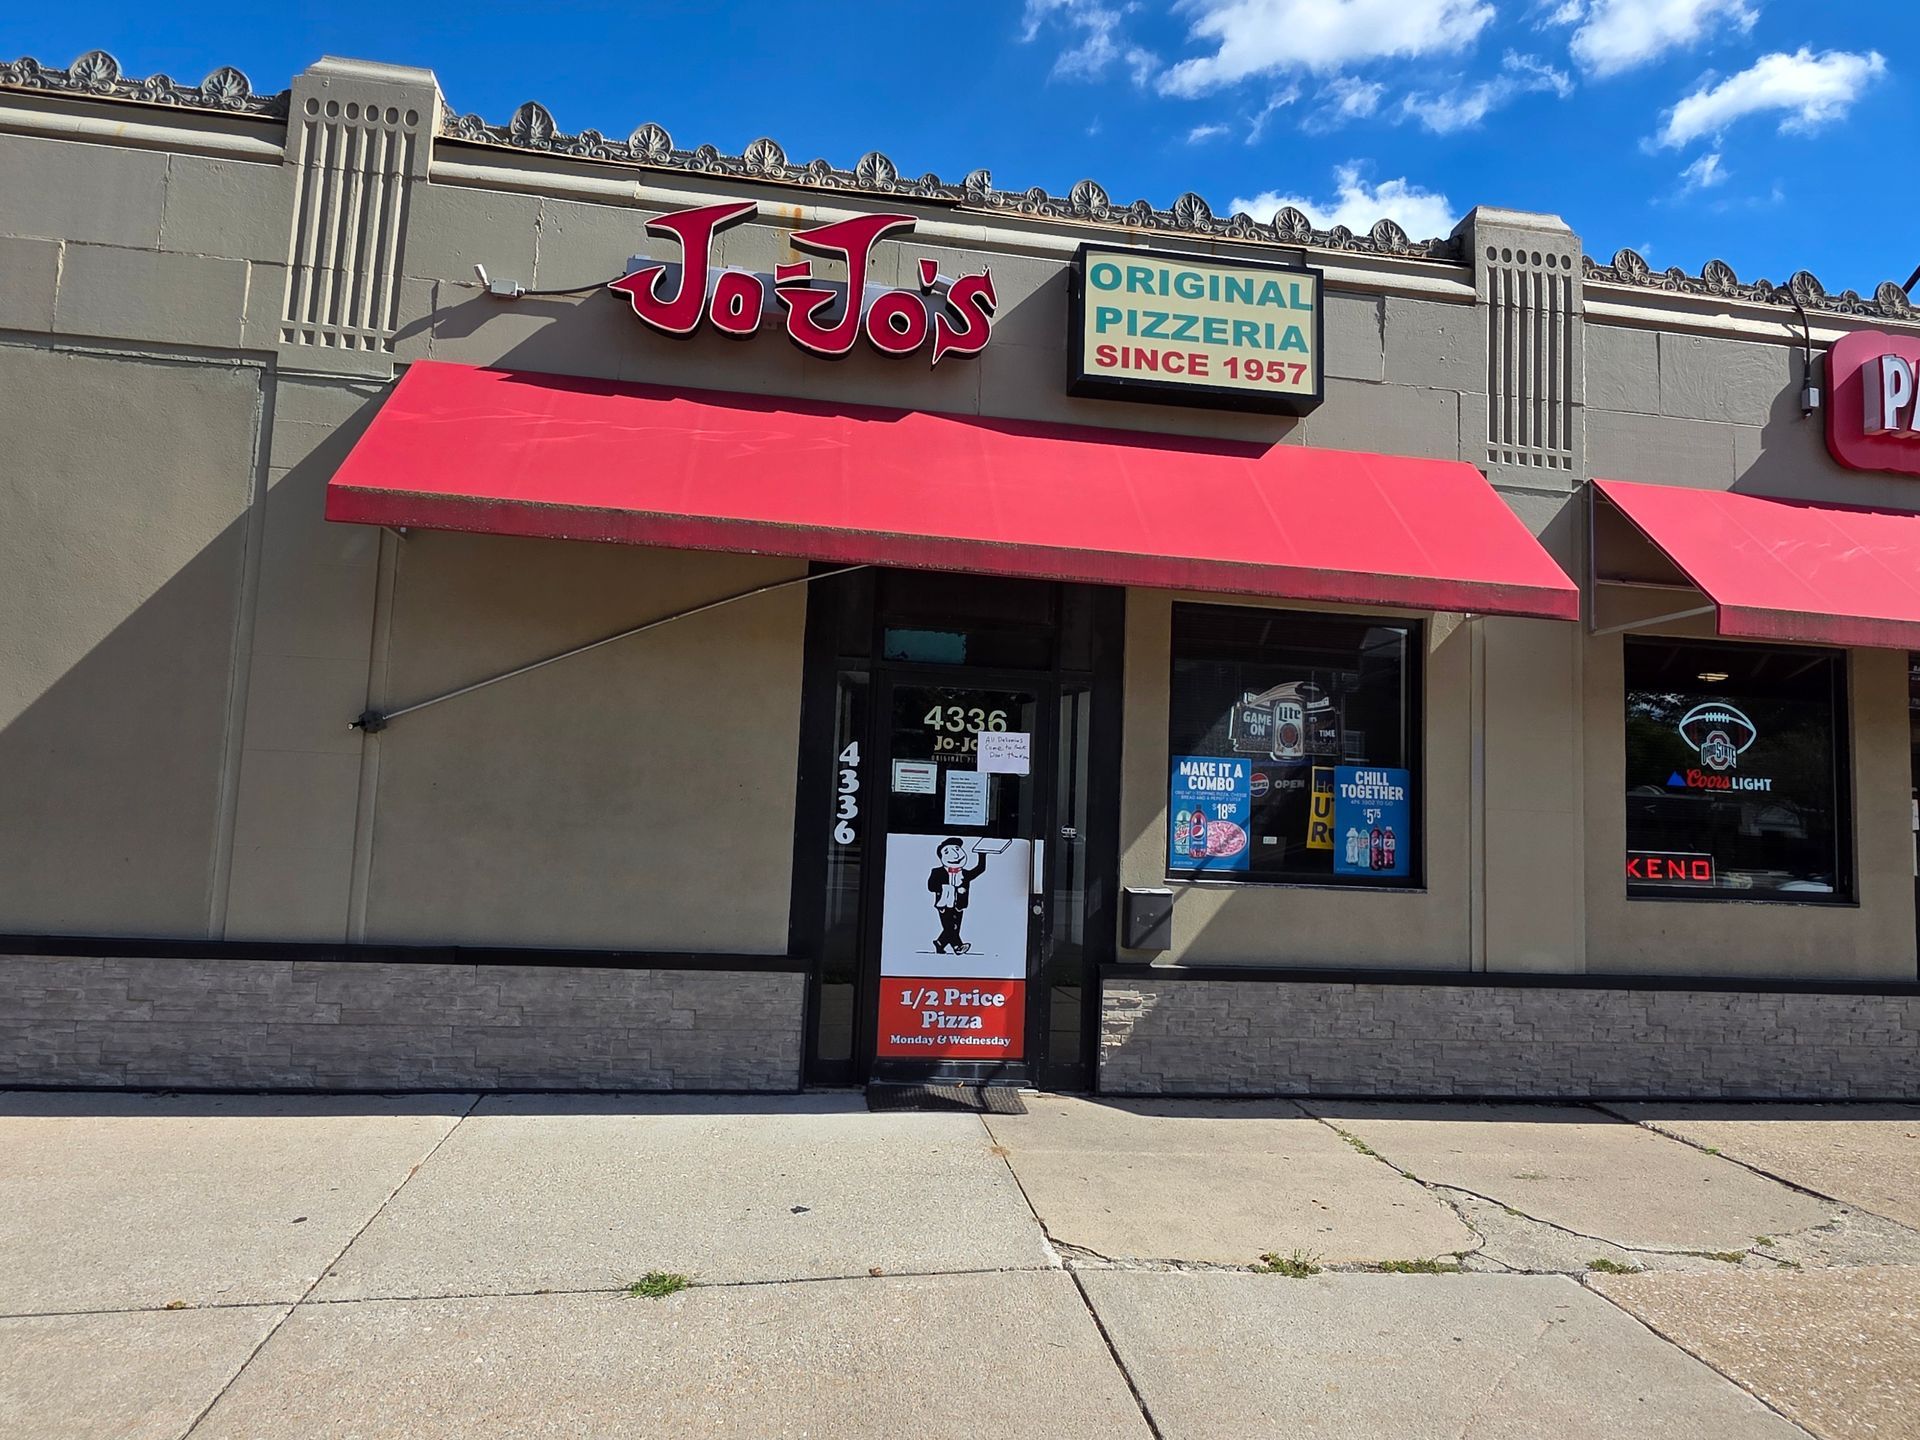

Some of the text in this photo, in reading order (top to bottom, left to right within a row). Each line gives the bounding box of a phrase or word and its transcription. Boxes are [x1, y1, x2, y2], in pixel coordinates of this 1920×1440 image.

[1090, 261, 1313, 313] ORIGINAL
[1095, 305, 1310, 354] PIZZERIA
[1094, 344, 1308, 386] SINCE 1957
[1881, 354, 1920, 431] P
[924, 706, 1007, 733] 4336
[1243, 711, 1272, 726] GAME
[1279, 706, 1301, 722] Lite
[1250, 724, 1266, 736] ON
[1319, 729, 1336, 738] TIME
[1180, 761, 1244, 778] MAKE IT A
[1187, 775, 1235, 791] COMBO
[1274, 779, 1305, 789] OPEN
[1355, 771, 1389, 786] CHILL
[1686, 769, 1772, 791] Coors LIGHT
[833, 741, 860, 845] 4336
[1340, 784, 1404, 800] TOGETHER
[1627, 857, 1711, 881] KENO
[900, 988, 1006, 1009] 1/2 Price
[921, 1011, 983, 1029] Pizza
[890, 1034, 1011, 1047] Monday & Wednesday
